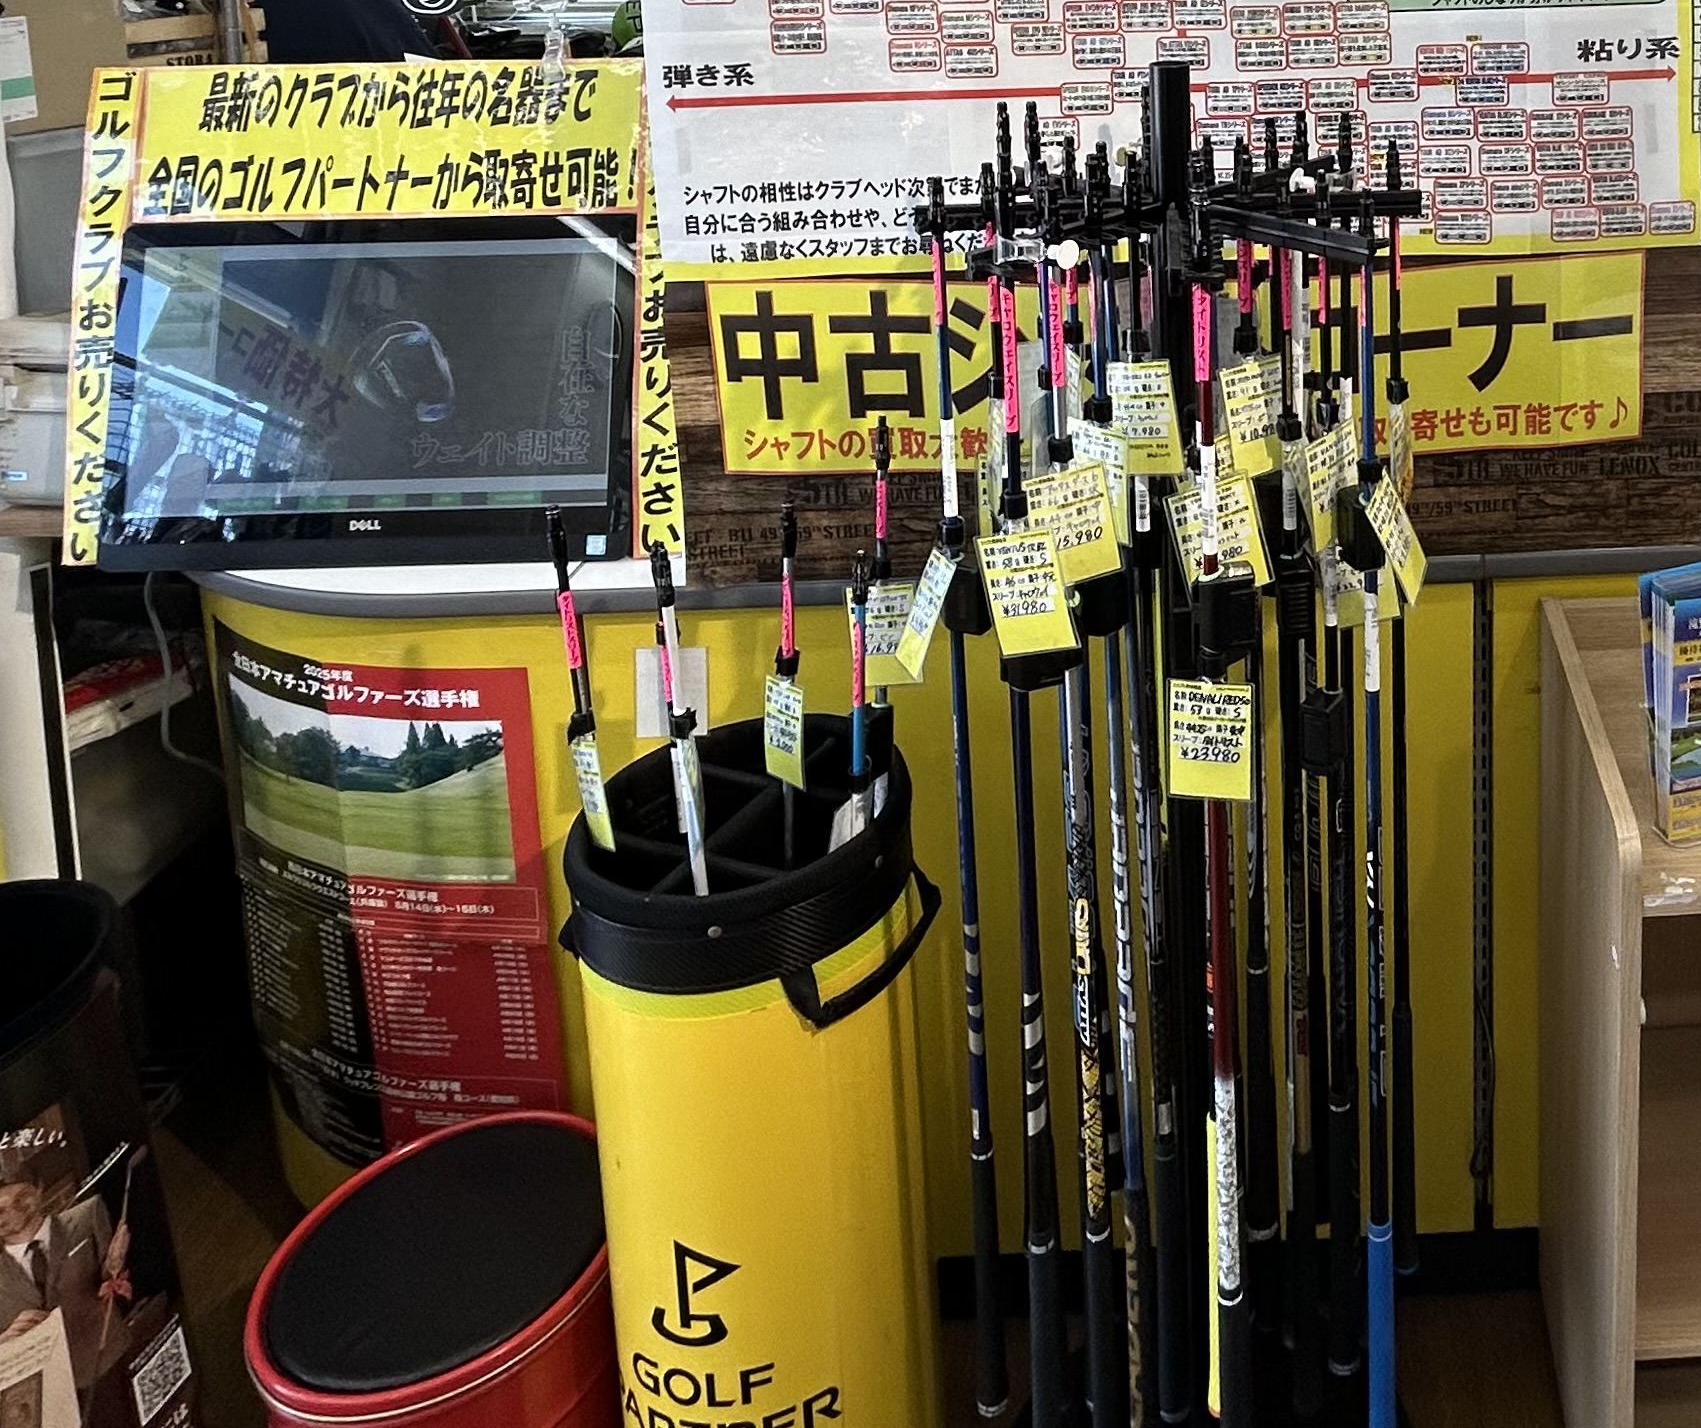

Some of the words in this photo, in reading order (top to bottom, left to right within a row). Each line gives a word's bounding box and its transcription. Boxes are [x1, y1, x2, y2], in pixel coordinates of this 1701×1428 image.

[662, 62, 755, 89] 弾き系
[1577, 35, 1681, 63] 粘り系
[199, 70, 599, 133] 最新のクラブから往年の名器まで
[141, 148, 637, 217] 全国のゴルフパートナーから取寄せ可能！
[70, 71, 136, 562] ゴルフクラブお売りください
[411, 429, 590, 468] ウェイト調整
[349, 519, 381, 532] DELL
[231, 650, 480, 710] 全日本アマチュアゴルファーズ選手権
[632, 1352, 775, 1408] GOLF
